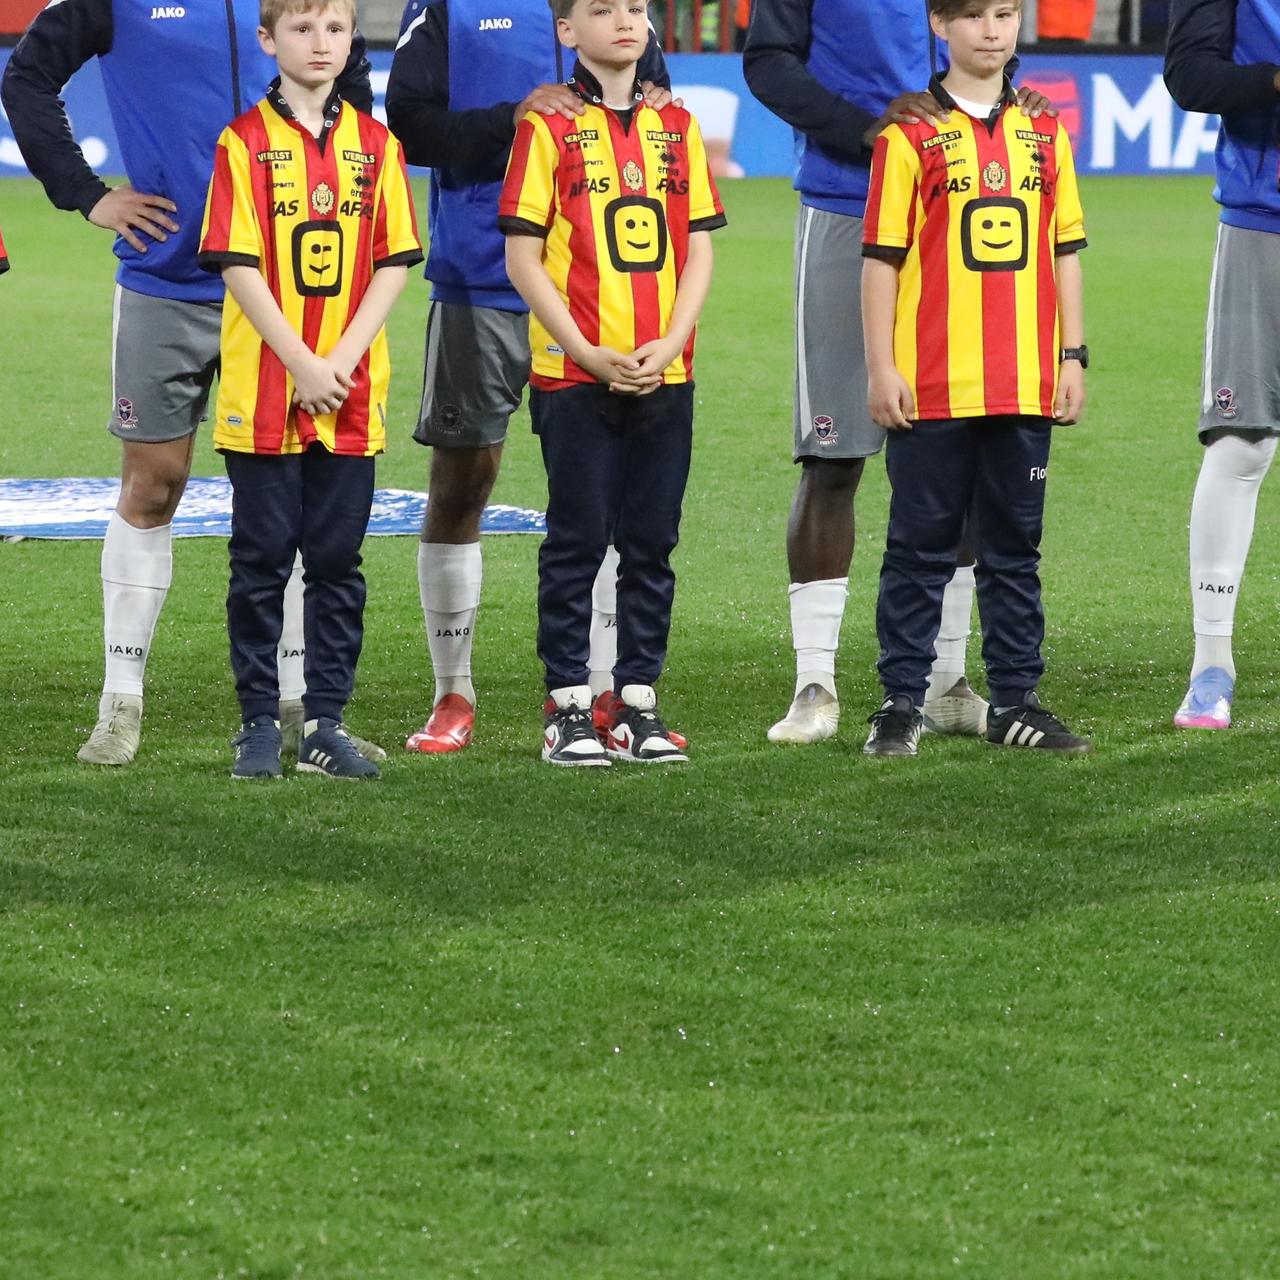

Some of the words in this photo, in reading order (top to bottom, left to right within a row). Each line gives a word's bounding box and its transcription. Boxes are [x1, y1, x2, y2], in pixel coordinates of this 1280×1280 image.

[151, 7, 185, 19] JAKO
[479, 18, 513, 30] JAKO
[647, 132, 681, 142] VERELST
[922, 132, 961, 148] VERELST
[1017, 131, 1052, 143] VERELST
[344, 151, 375, 163] VERELS
[1199, 581, 1234, 594] JAKO
[435, 627, 469, 638] JAKO
[109, 644, 143, 657] JAKO
